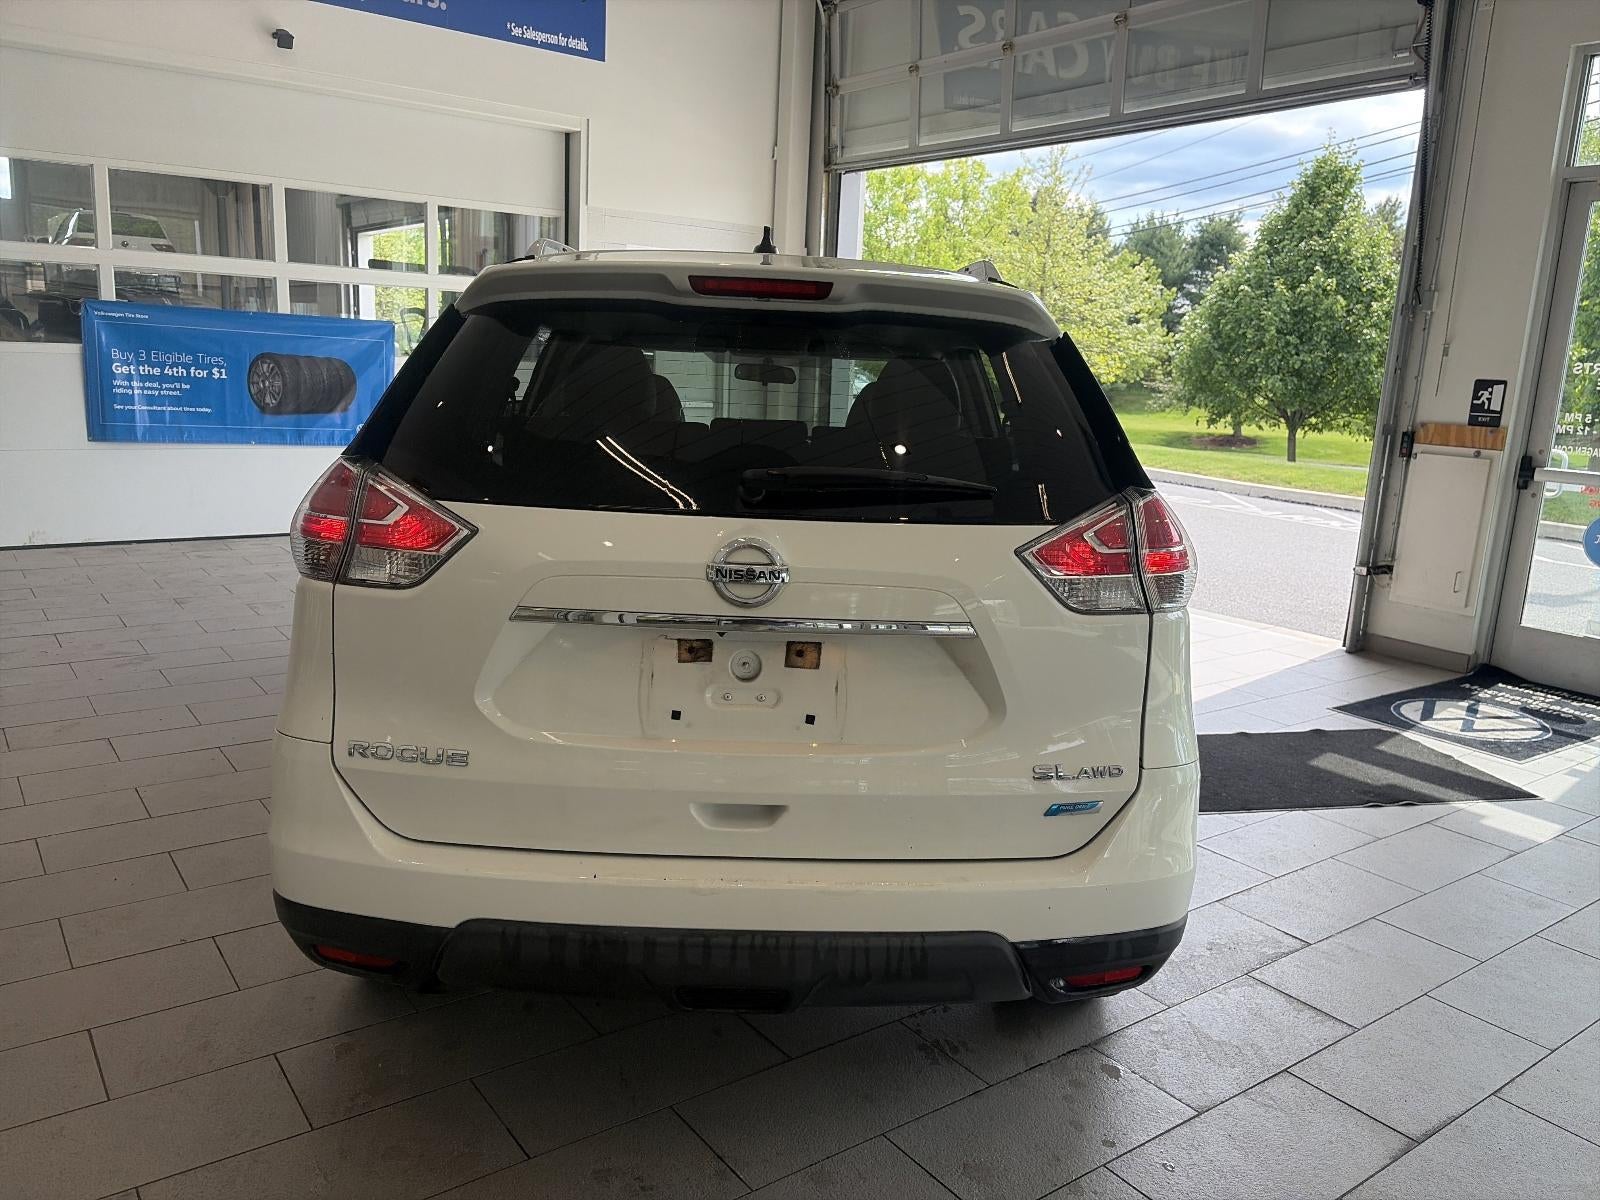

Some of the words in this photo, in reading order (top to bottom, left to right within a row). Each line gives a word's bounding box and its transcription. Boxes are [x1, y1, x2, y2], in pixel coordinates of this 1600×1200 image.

[522, 25, 558, 45] Salesperson
[558, 32, 568, 47] for
[567, 35, 589, 52] details.
[111, 348, 134, 363] Buy
[138, 349, 147, 361] 3
[151, 350, 193, 365] Eligible
[196, 353, 227, 367] Tires,
[111, 362, 136, 374] Get
[139, 365, 161, 375] the
[163, 365, 187, 377] 4th
[190, 367, 209, 378] for
[211, 366, 228, 380] $1
[112, 379, 130, 387] With
[130, 380, 143, 388] this
[144, 381, 161, 389] deal,
[181, 382, 191, 390] be
[112, 387, 133, 396] riding
[715, 565, 784, 583] NISSAN
[347, 739, 470, 767] ROGUE
